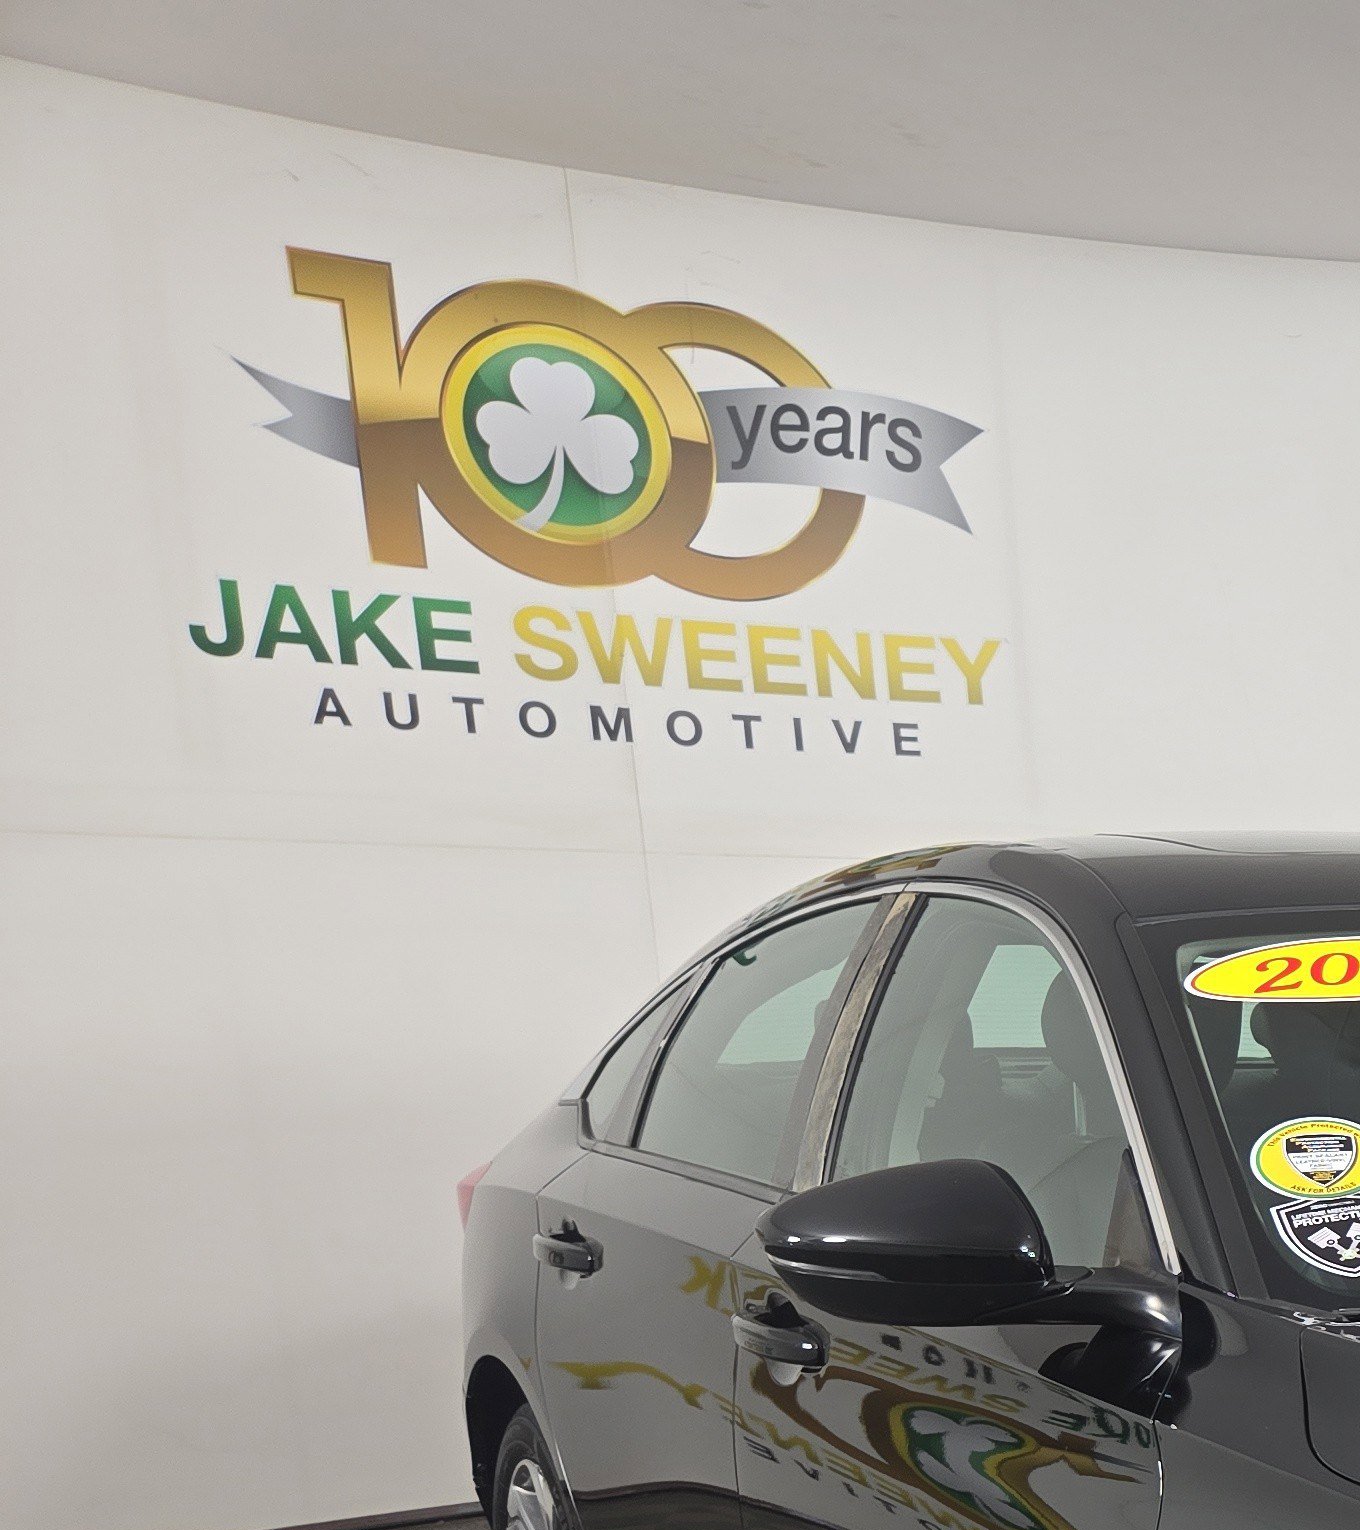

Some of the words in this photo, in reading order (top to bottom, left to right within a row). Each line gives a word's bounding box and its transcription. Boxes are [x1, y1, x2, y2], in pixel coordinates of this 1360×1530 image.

[285, 246, 865, 602] 100
[726, 402, 925, 474] years
[188, 578, 481, 675] JAKE
[511, 605, 1001, 706] SWEENEY
[313, 687, 922, 757] AUTOMOTIVE
